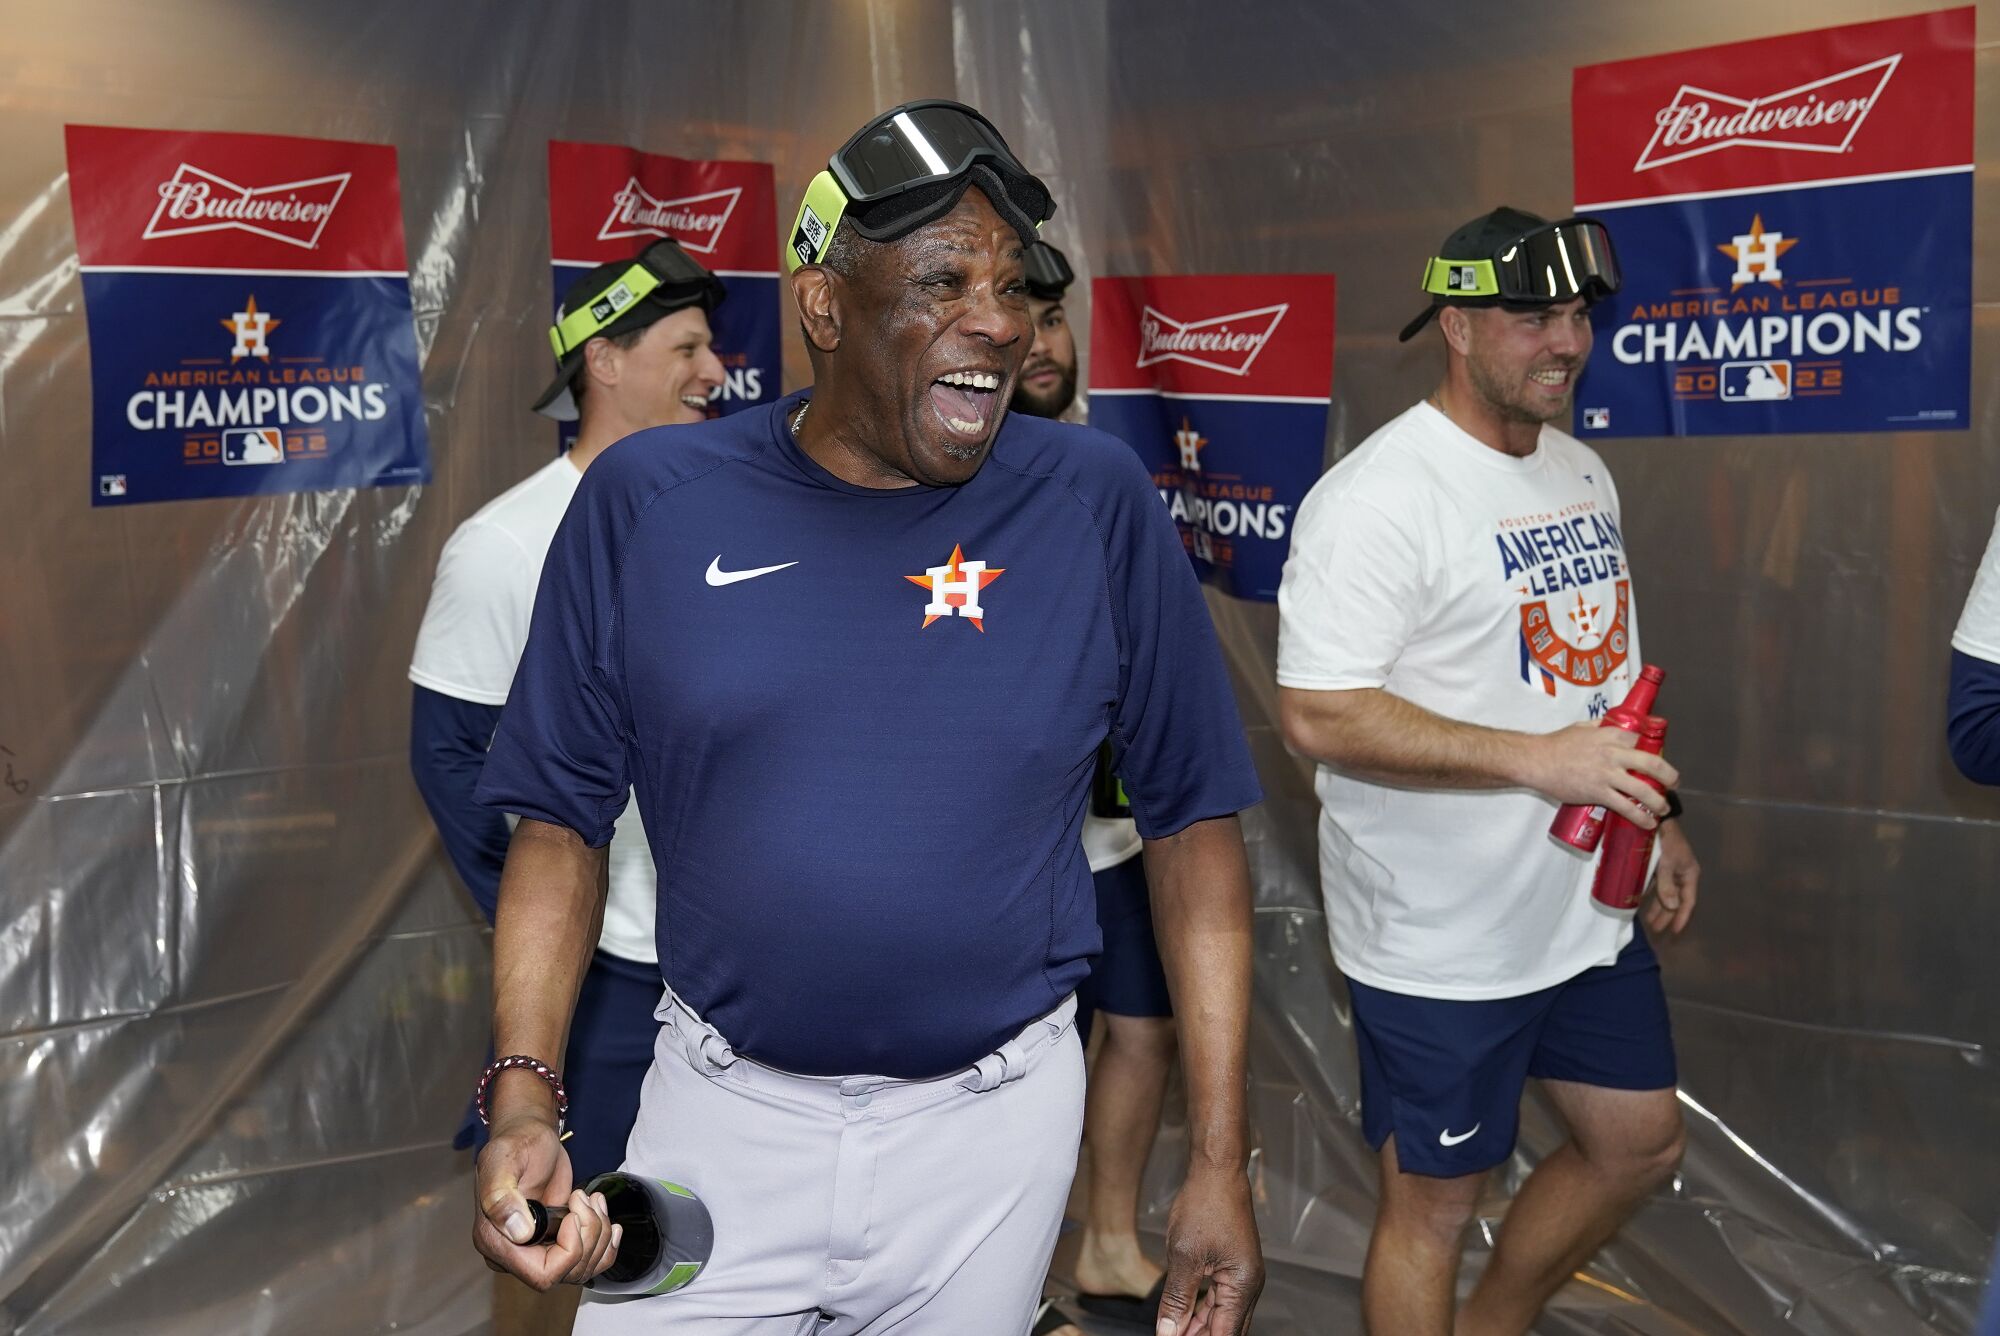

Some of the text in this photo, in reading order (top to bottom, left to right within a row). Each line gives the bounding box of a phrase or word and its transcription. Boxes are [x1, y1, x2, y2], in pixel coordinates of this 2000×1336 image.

[1655, 94, 1872, 147] Budweiser
[157, 181, 332, 222] Budweiser
[1731, 232, 1783, 284] H
[1631, 287, 1900, 321] AMERICAN LEAGUE
[231, 312, 271, 357] H
[1141, 320, 1264, 352] Budweiser
[1612, 307, 1922, 365] CHAMPIONS
[145, 367, 366, 386] AMERICAN LEAGUE
[1674, 370, 1843, 392] 20 22
[127, 385, 387, 430] CHAMPIONS
[184, 435, 327, 458] 20 22
[1498, 513, 1553, 529] HOUSTON
[1496, 511, 1622, 582] AMERICAN
[925, 560, 986, 619] H
[1530, 554, 1620, 597] LEAGUE
